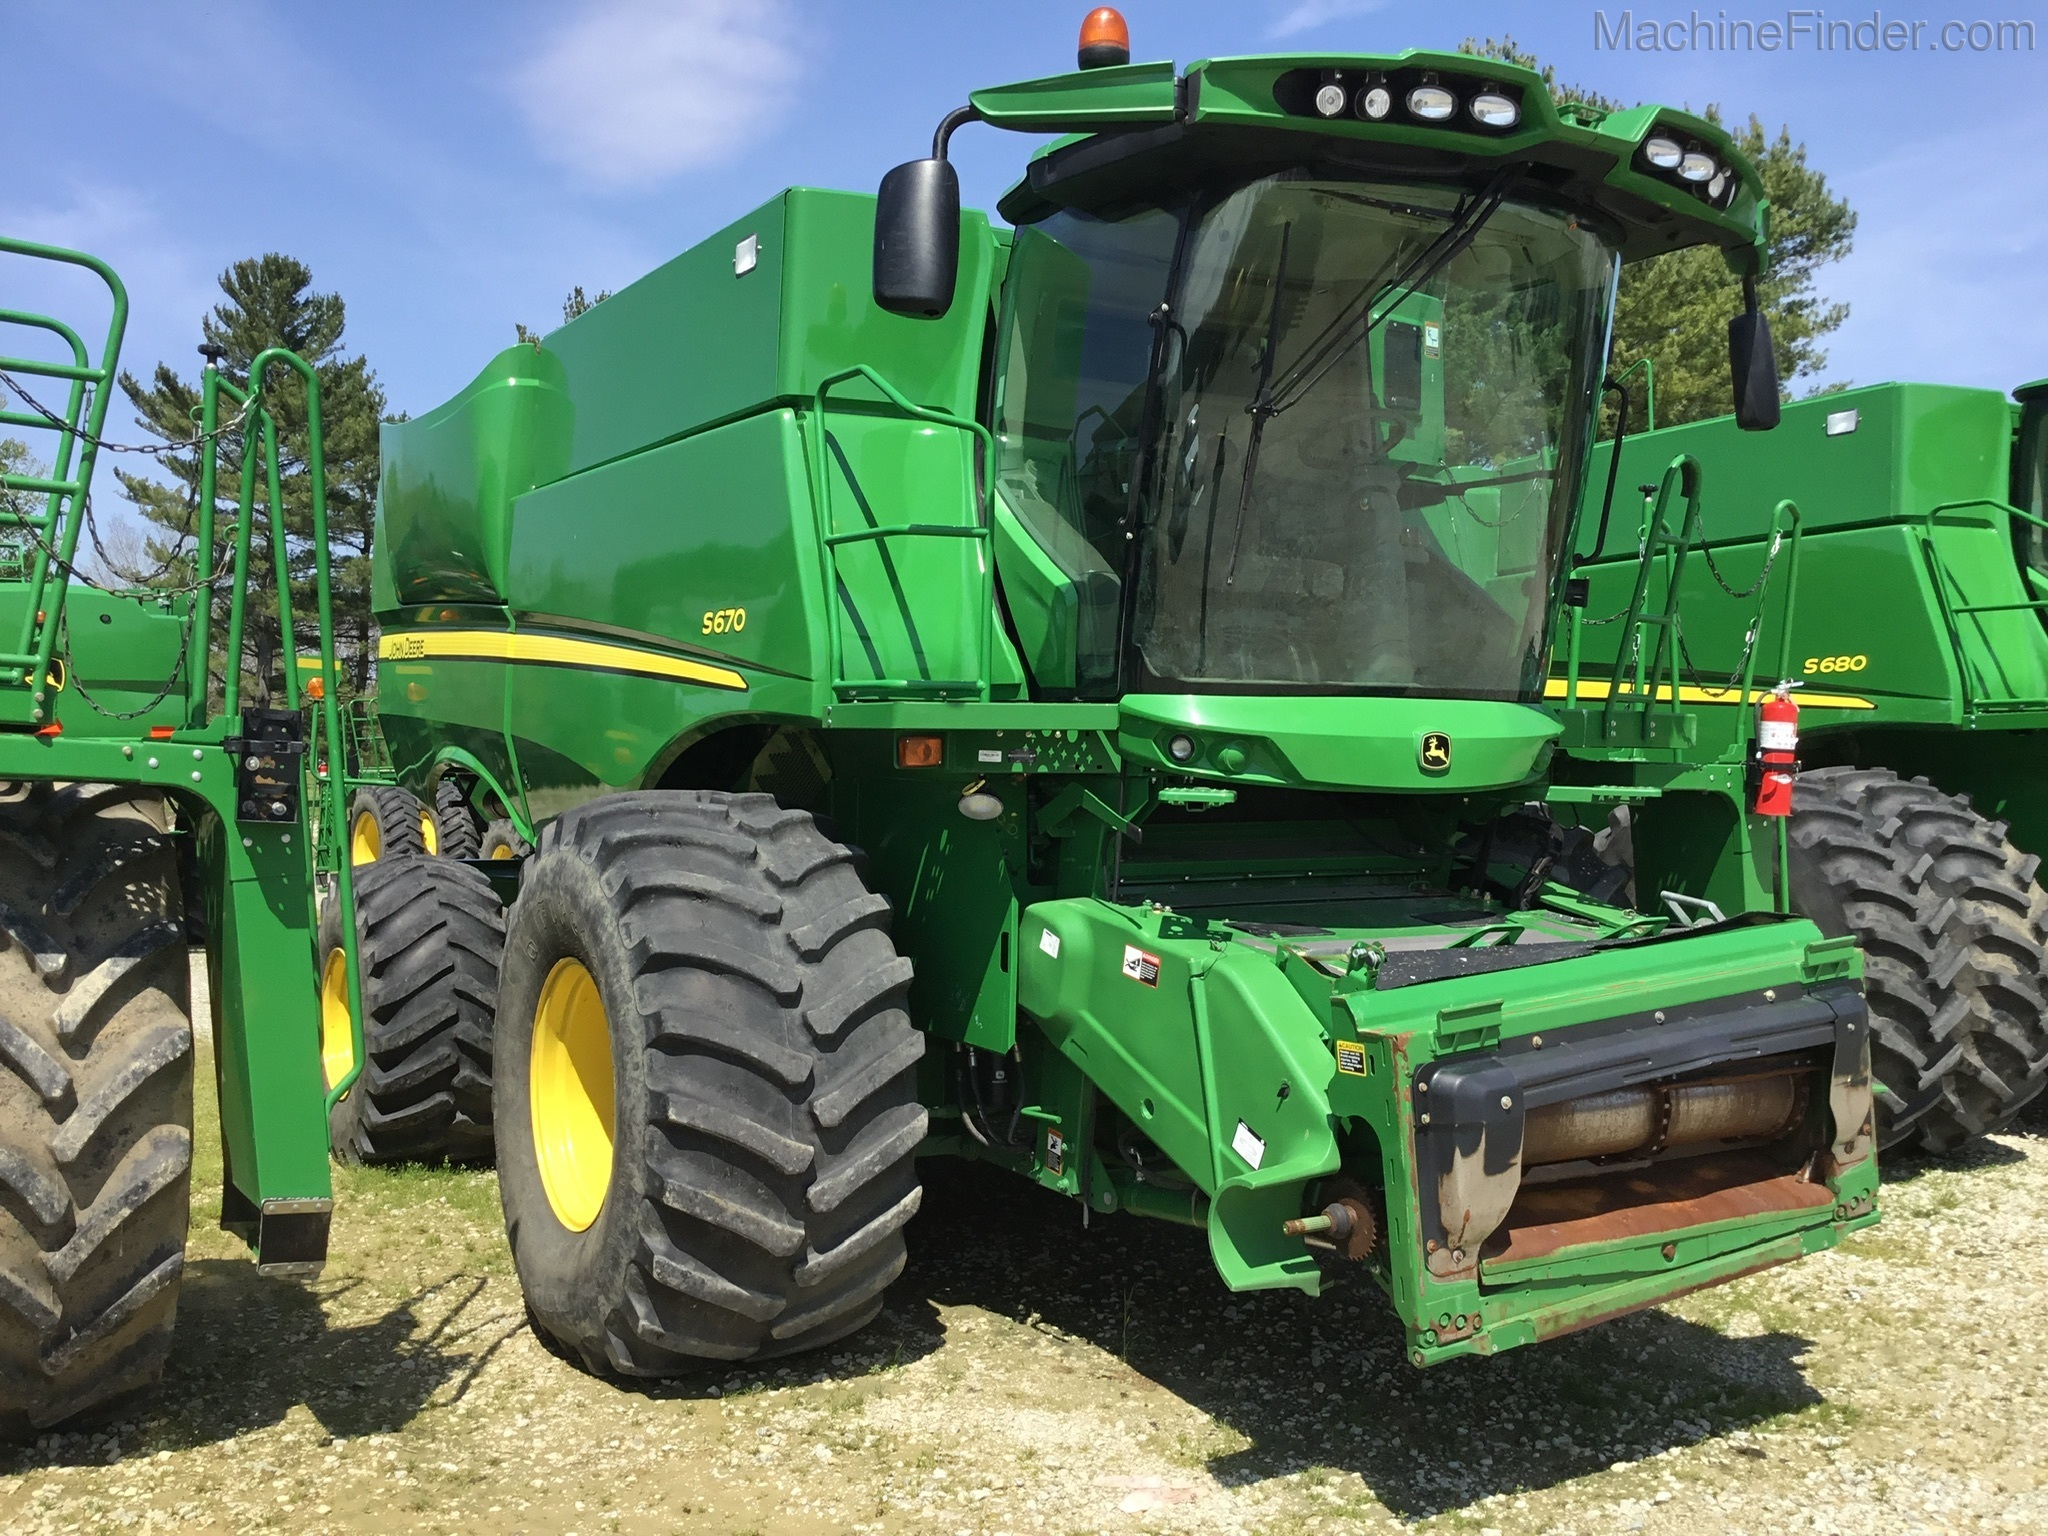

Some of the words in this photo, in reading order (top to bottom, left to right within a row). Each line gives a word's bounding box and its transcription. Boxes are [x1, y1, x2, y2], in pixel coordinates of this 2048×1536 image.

[701, 607, 746, 635] S670
[389, 640, 405, 658] JOHN
[404, 637, 424, 657] DEERE
[1803, 655, 1867, 674] S680
